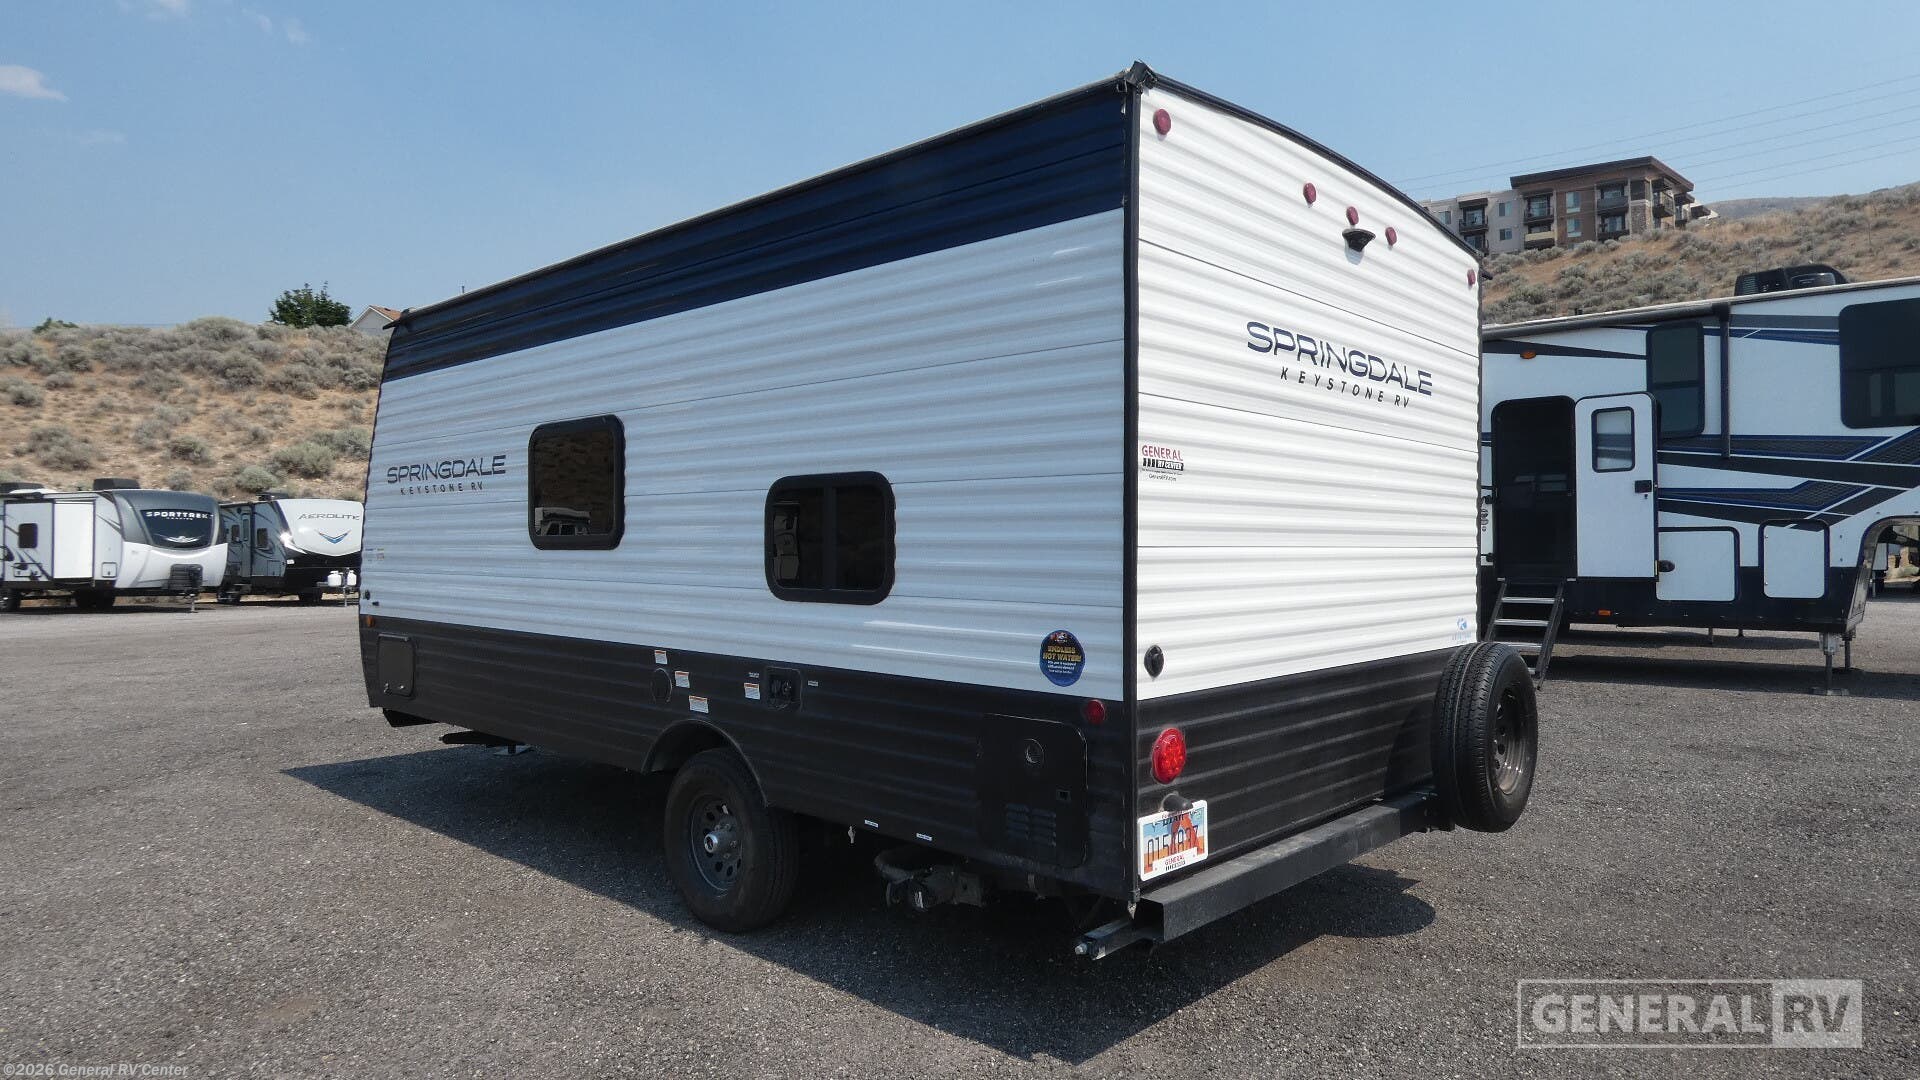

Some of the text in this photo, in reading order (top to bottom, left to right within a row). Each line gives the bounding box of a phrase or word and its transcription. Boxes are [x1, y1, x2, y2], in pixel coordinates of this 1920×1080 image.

[1246, 321, 1433, 397] SPRINGDALE
[1280, 366, 1410, 408] KEYSTONE RV
[1141, 444, 1184, 462] GENERAL
[387, 454, 507, 484] SPRINGDALE
[400, 481, 483, 496] KEYSTONE RV
[146, 511, 209, 519] SPORTTREK
[298, 513, 360, 521] AEROLITE
